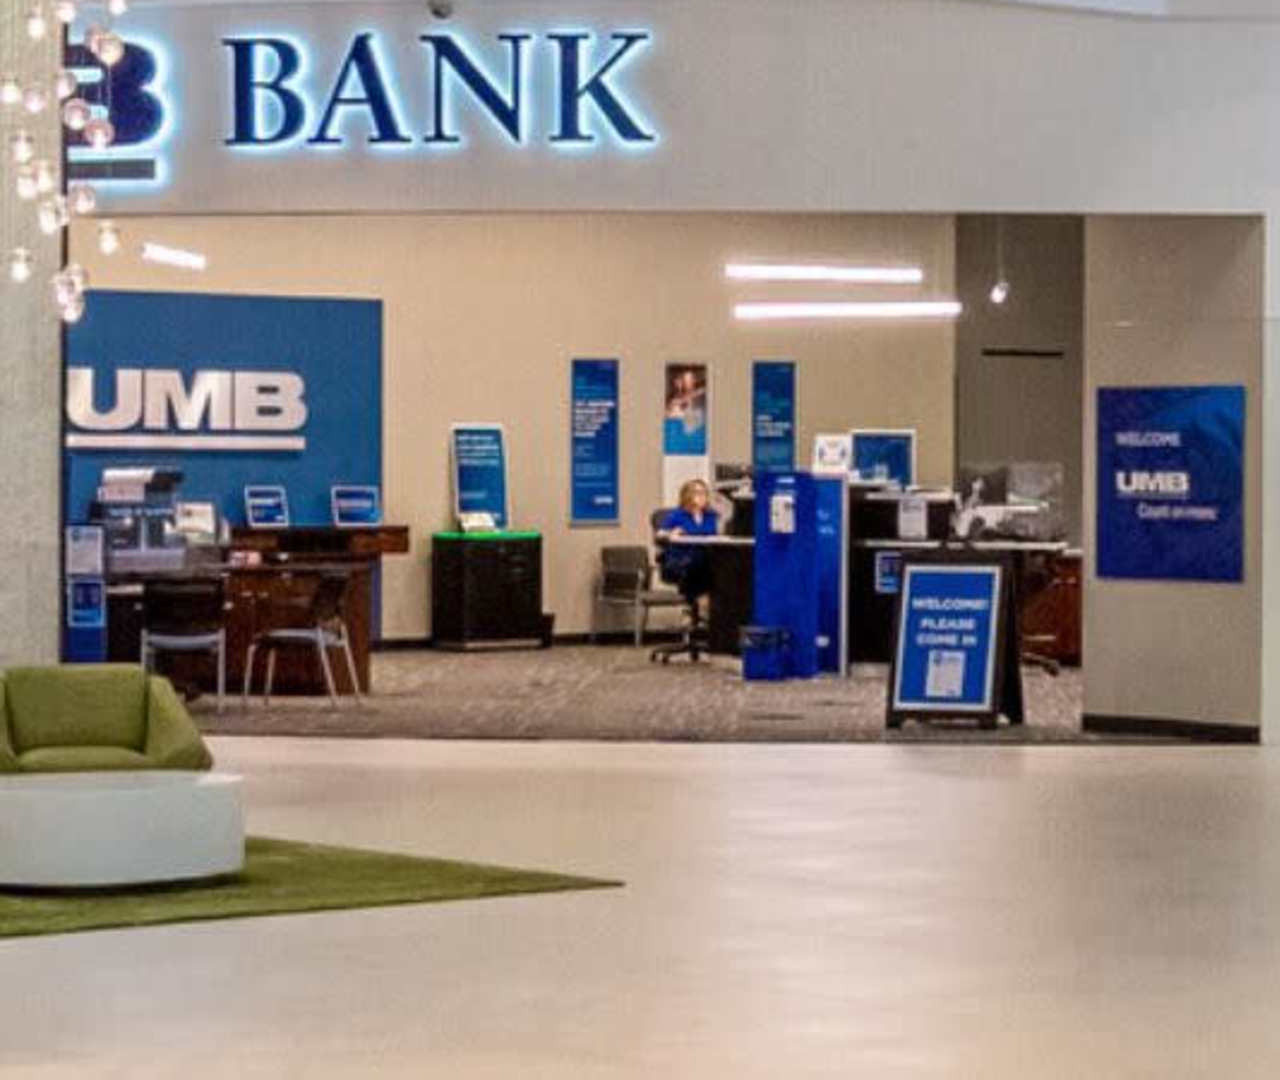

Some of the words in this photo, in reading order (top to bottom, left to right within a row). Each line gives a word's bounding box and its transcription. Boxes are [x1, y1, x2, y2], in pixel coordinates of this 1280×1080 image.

[223, 33, 654, 147] BANK
[66, 367, 309, 431] UMB
[1115, 432, 1181, 447] WELCOME
[1115, 471, 1190, 494] UMB
[920, 617, 976, 631] PLEASE
[916, 633, 957, 647] COME
[961, 634, 977, 647] IN
